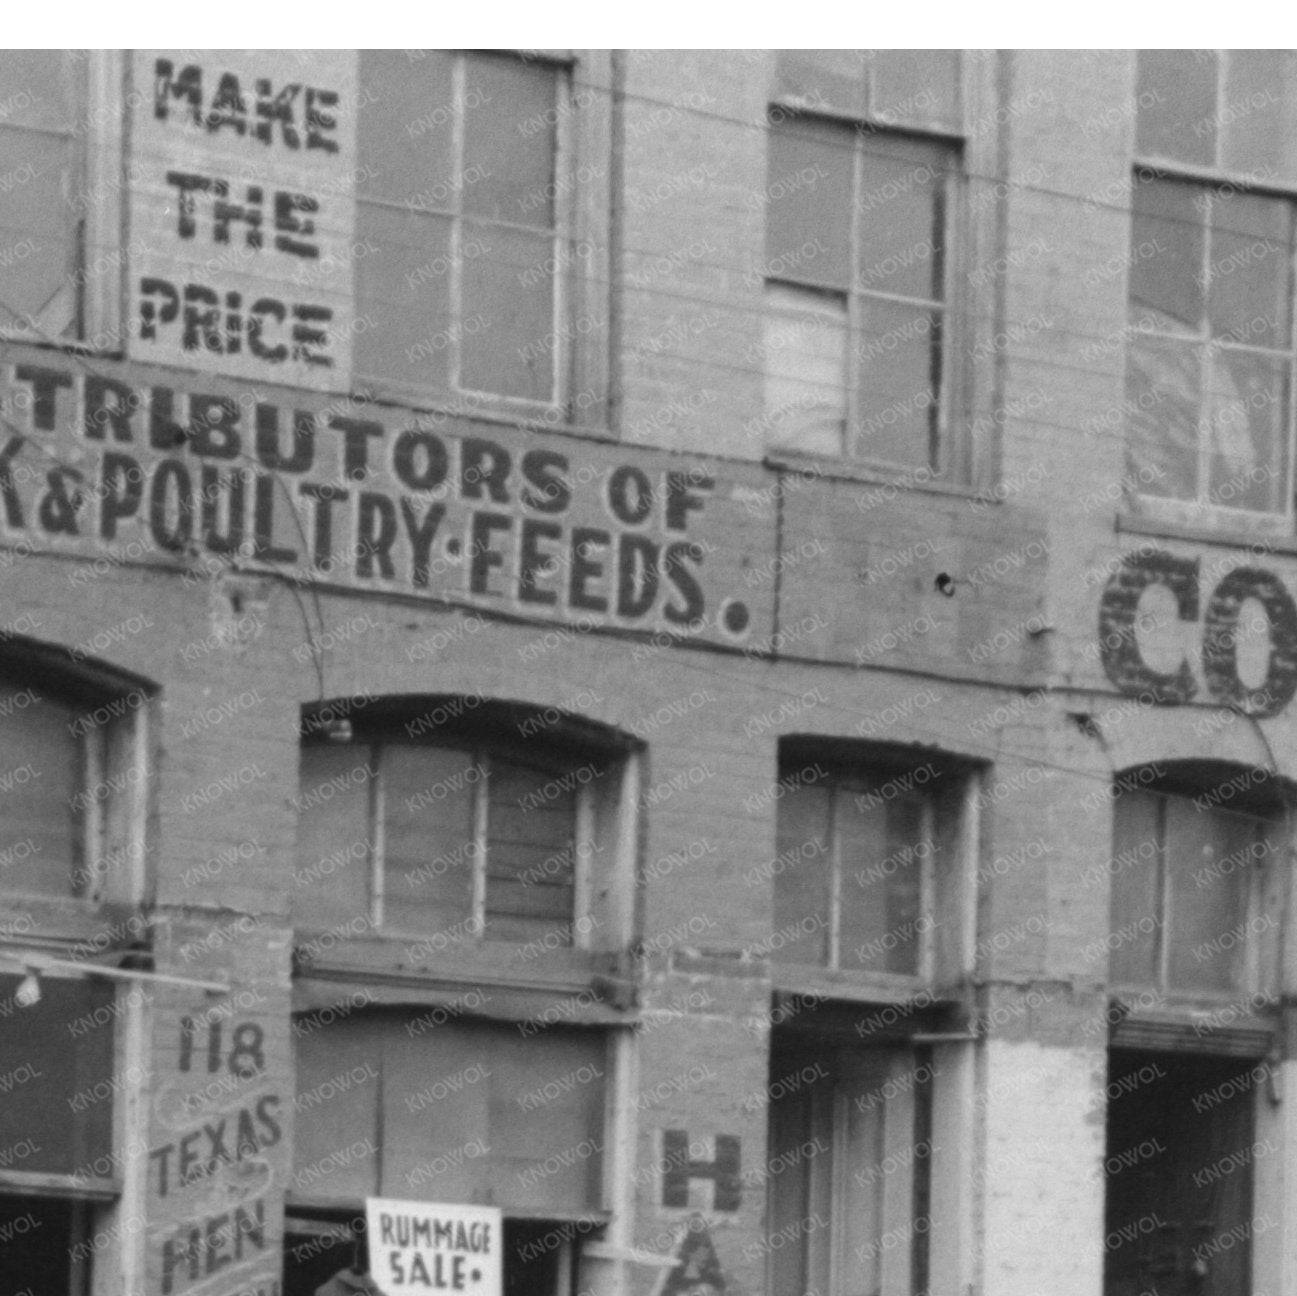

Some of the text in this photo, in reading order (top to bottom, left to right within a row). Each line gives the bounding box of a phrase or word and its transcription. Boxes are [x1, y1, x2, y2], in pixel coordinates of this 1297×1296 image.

[154, 57, 339, 154] MAKE
[166, 169, 320, 259] THE
[139, 276, 335, 369] PRICE
[608, 464, 716, 531] OF
[179, 1016, 265, 1079] 118
[150, 1095, 282, 1198] TEXAS
[162, 1200, 264, 1296] HEN
[379, 1212, 491, 1254] RUMMAGE
